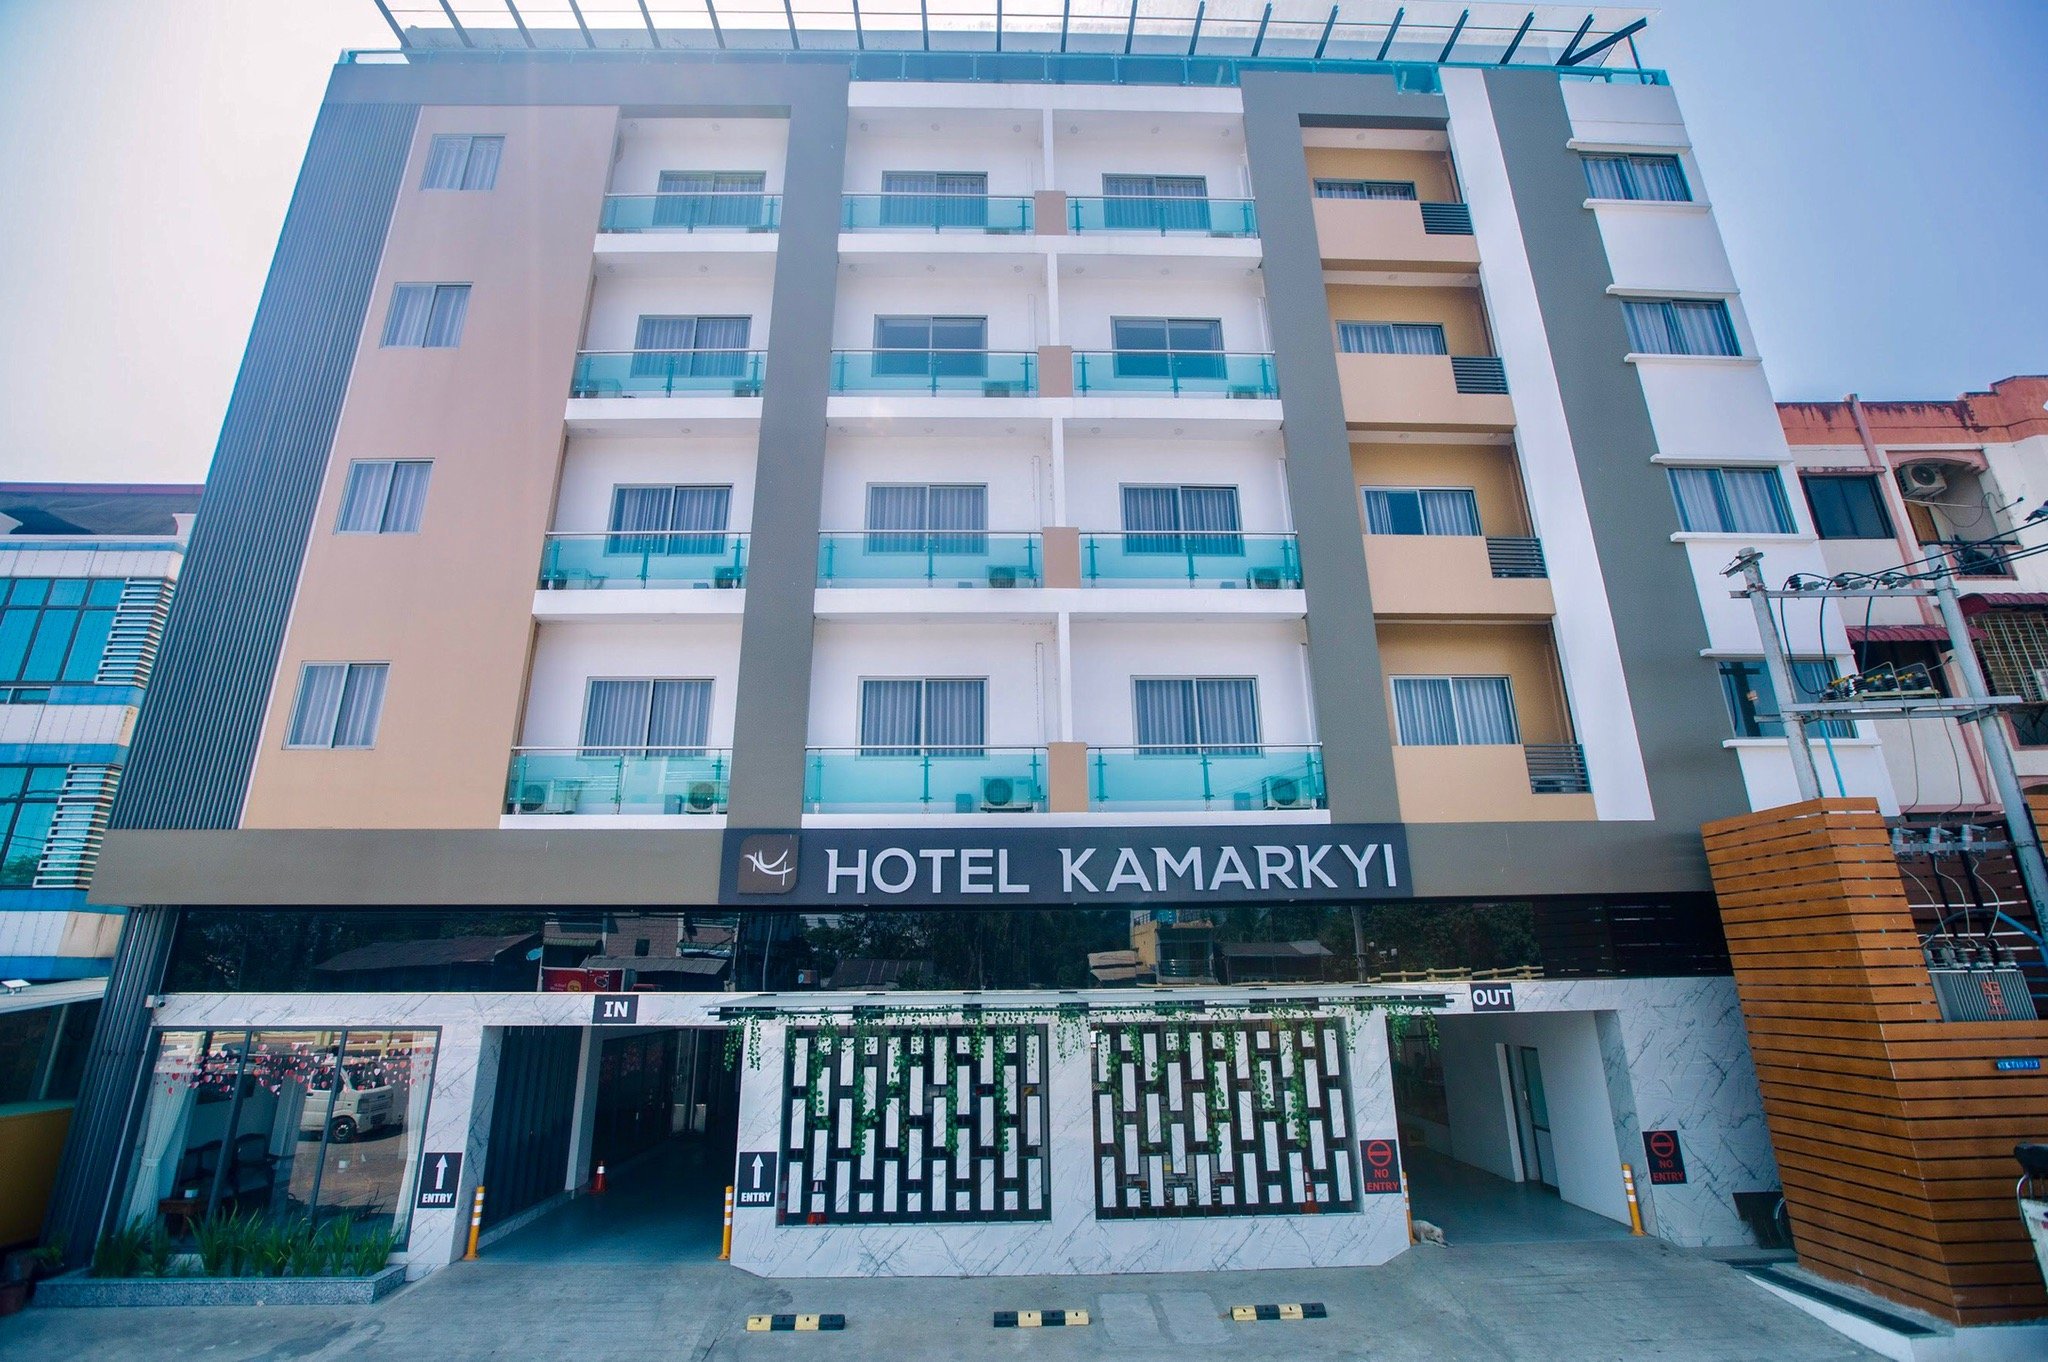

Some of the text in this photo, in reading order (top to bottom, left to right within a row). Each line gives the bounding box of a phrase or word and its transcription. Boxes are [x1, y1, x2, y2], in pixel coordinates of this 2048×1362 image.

[825, 843, 1397, 894] HOTEL KAMARKYI
[1472, 989, 1512, 1006] OUT
[603, 1001, 628, 1018] IN
[1658, 1159, 1673, 1168] NO
[1374, 1168, 1389, 1179] NO
[1652, 1171, 1684, 1181] ENTRY
[1366, 1181, 1399, 1191] ENTRY
[421, 1193, 453, 1203] ENTRY
[740, 1192, 771, 1202] ENTRY
